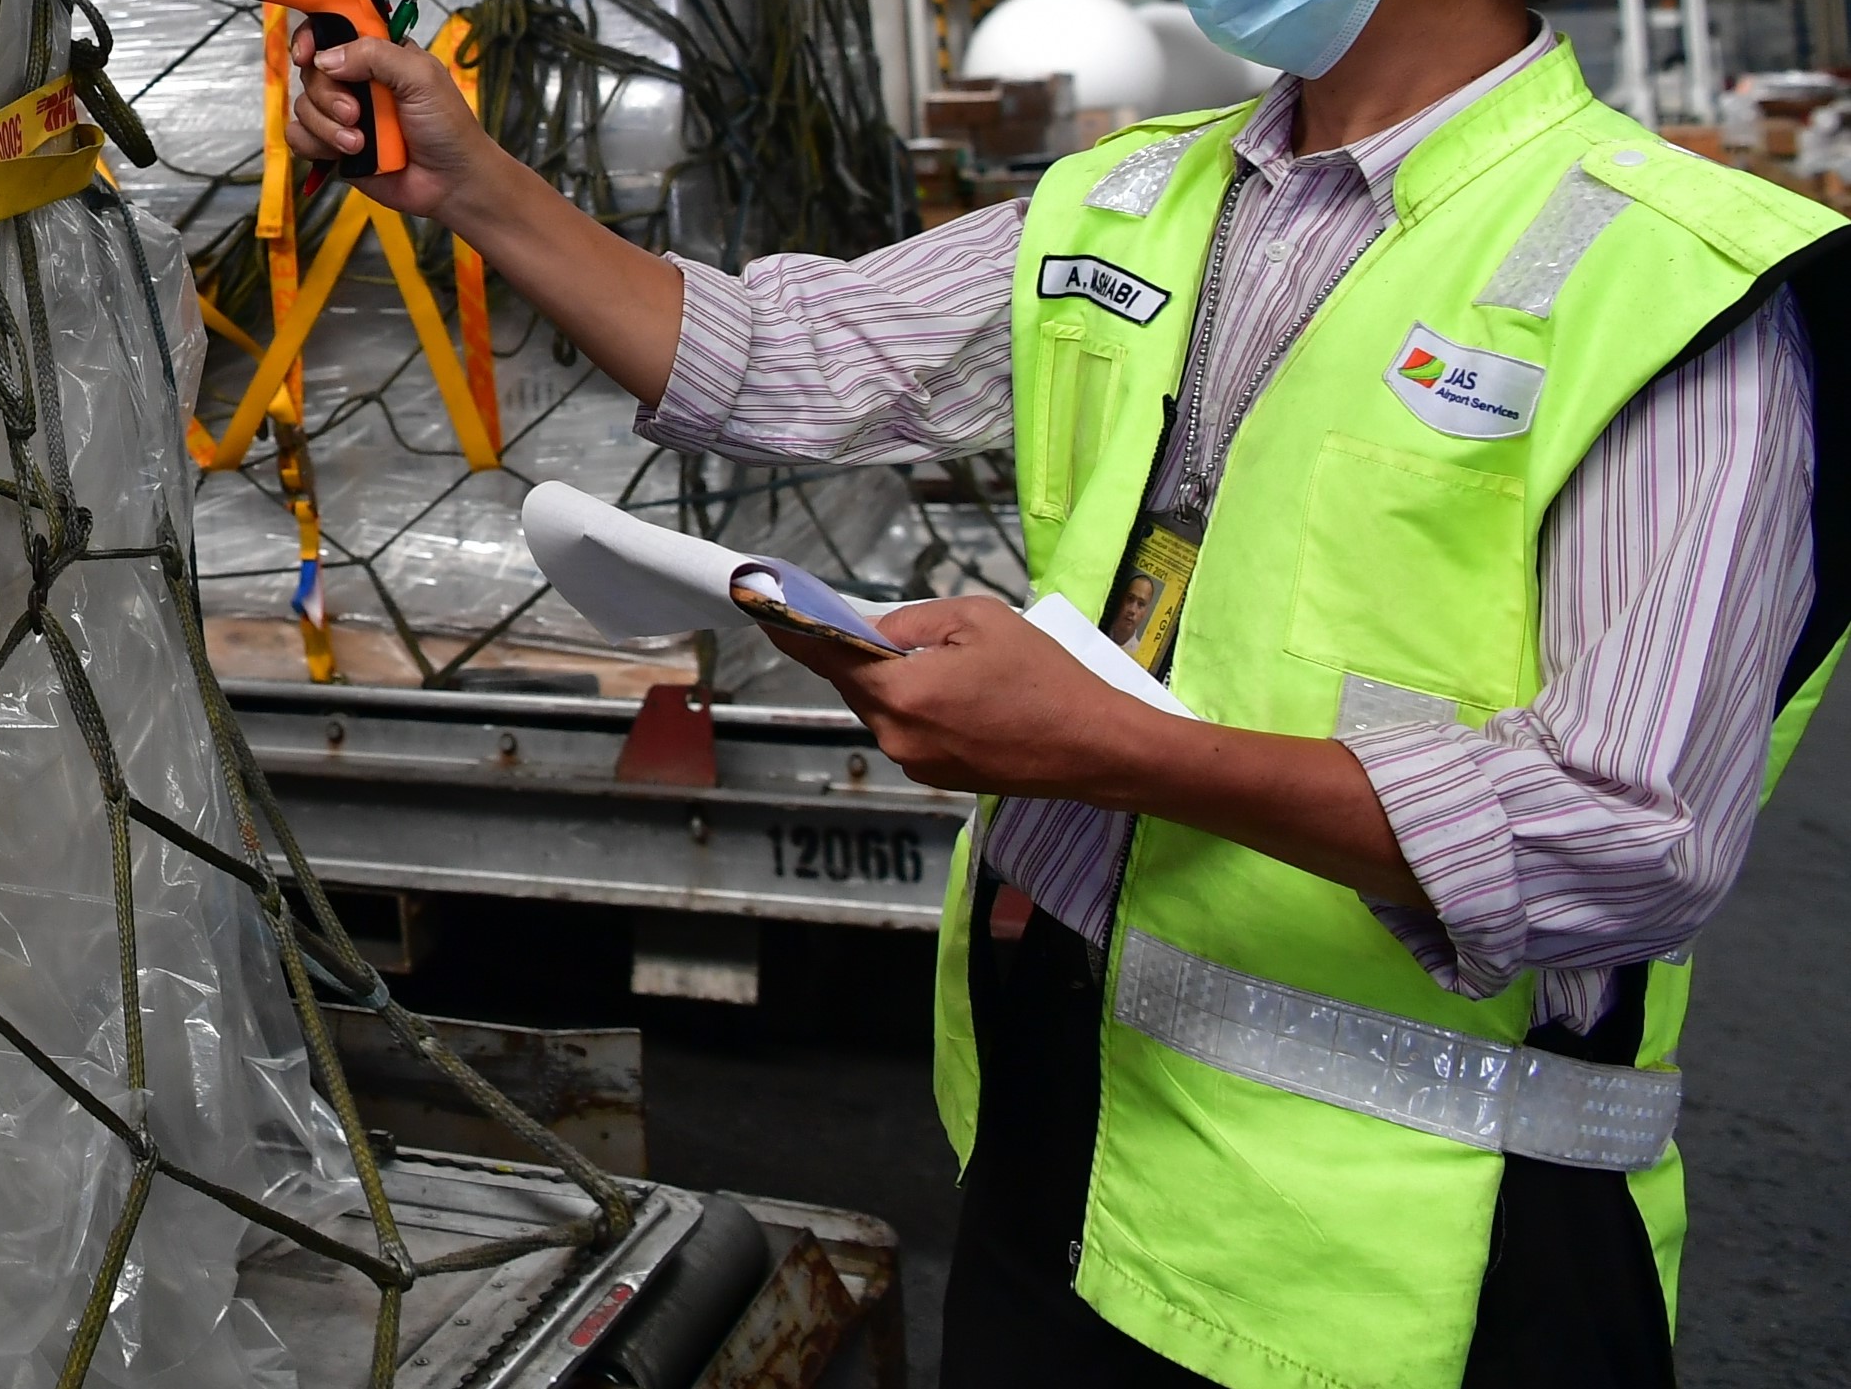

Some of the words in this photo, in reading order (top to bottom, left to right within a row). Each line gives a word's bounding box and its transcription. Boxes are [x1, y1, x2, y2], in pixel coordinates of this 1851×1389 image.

[1444, 367, 1479, 390] JAS
[1435, 386, 1470, 406] Airport
[1470, 397, 1520, 420] Services
[1139, 557, 1157, 573] OKT
[765, 825, 923, 883] 12066
